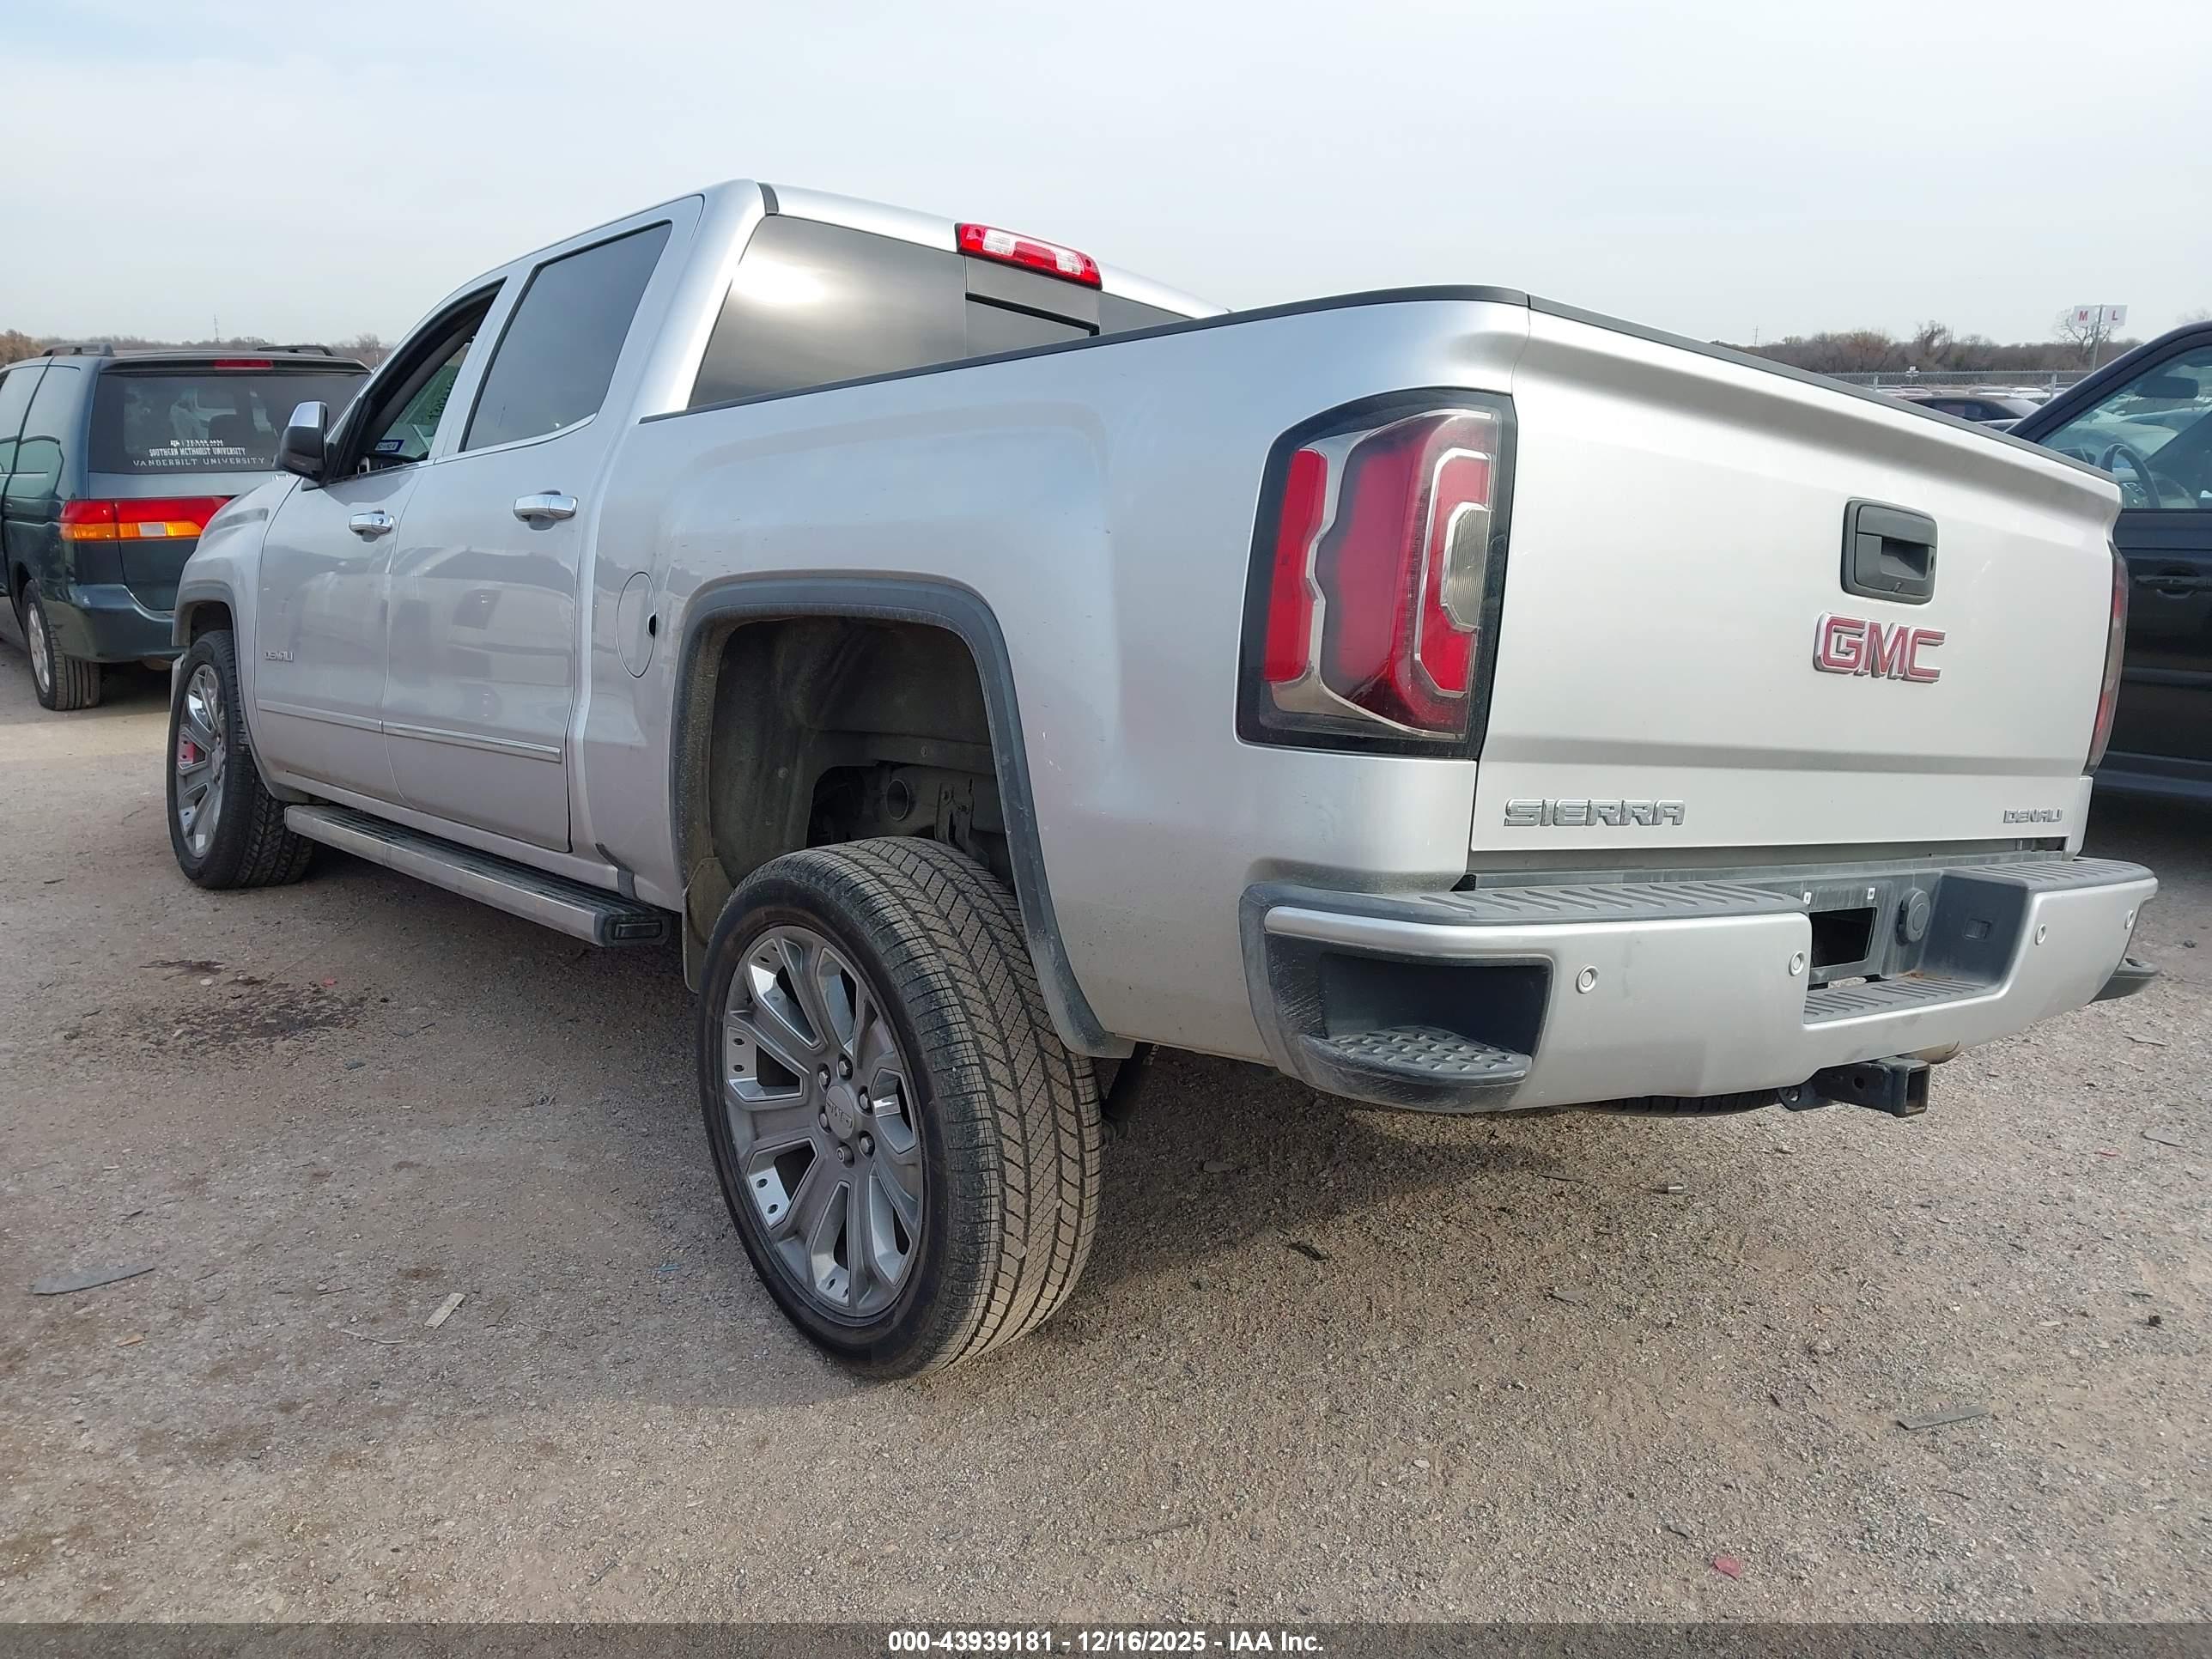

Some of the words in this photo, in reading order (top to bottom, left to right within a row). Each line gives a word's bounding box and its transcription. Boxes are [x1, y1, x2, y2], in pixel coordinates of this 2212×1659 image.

[2078, 310, 2088, 321] M
[2112, 309, 2118, 321] L
[149, 447, 179, 457] SOUTHERN
[212, 447, 246, 455] UNIVERSITY
[133, 458, 198, 466] VANDERBILT
[203, 457, 265, 465] UNIVERSITY
[1813, 611, 1946, 684] GMC
[1504, 798, 1686, 826] SIERRA
[2002, 808, 2063, 823] DENALI
